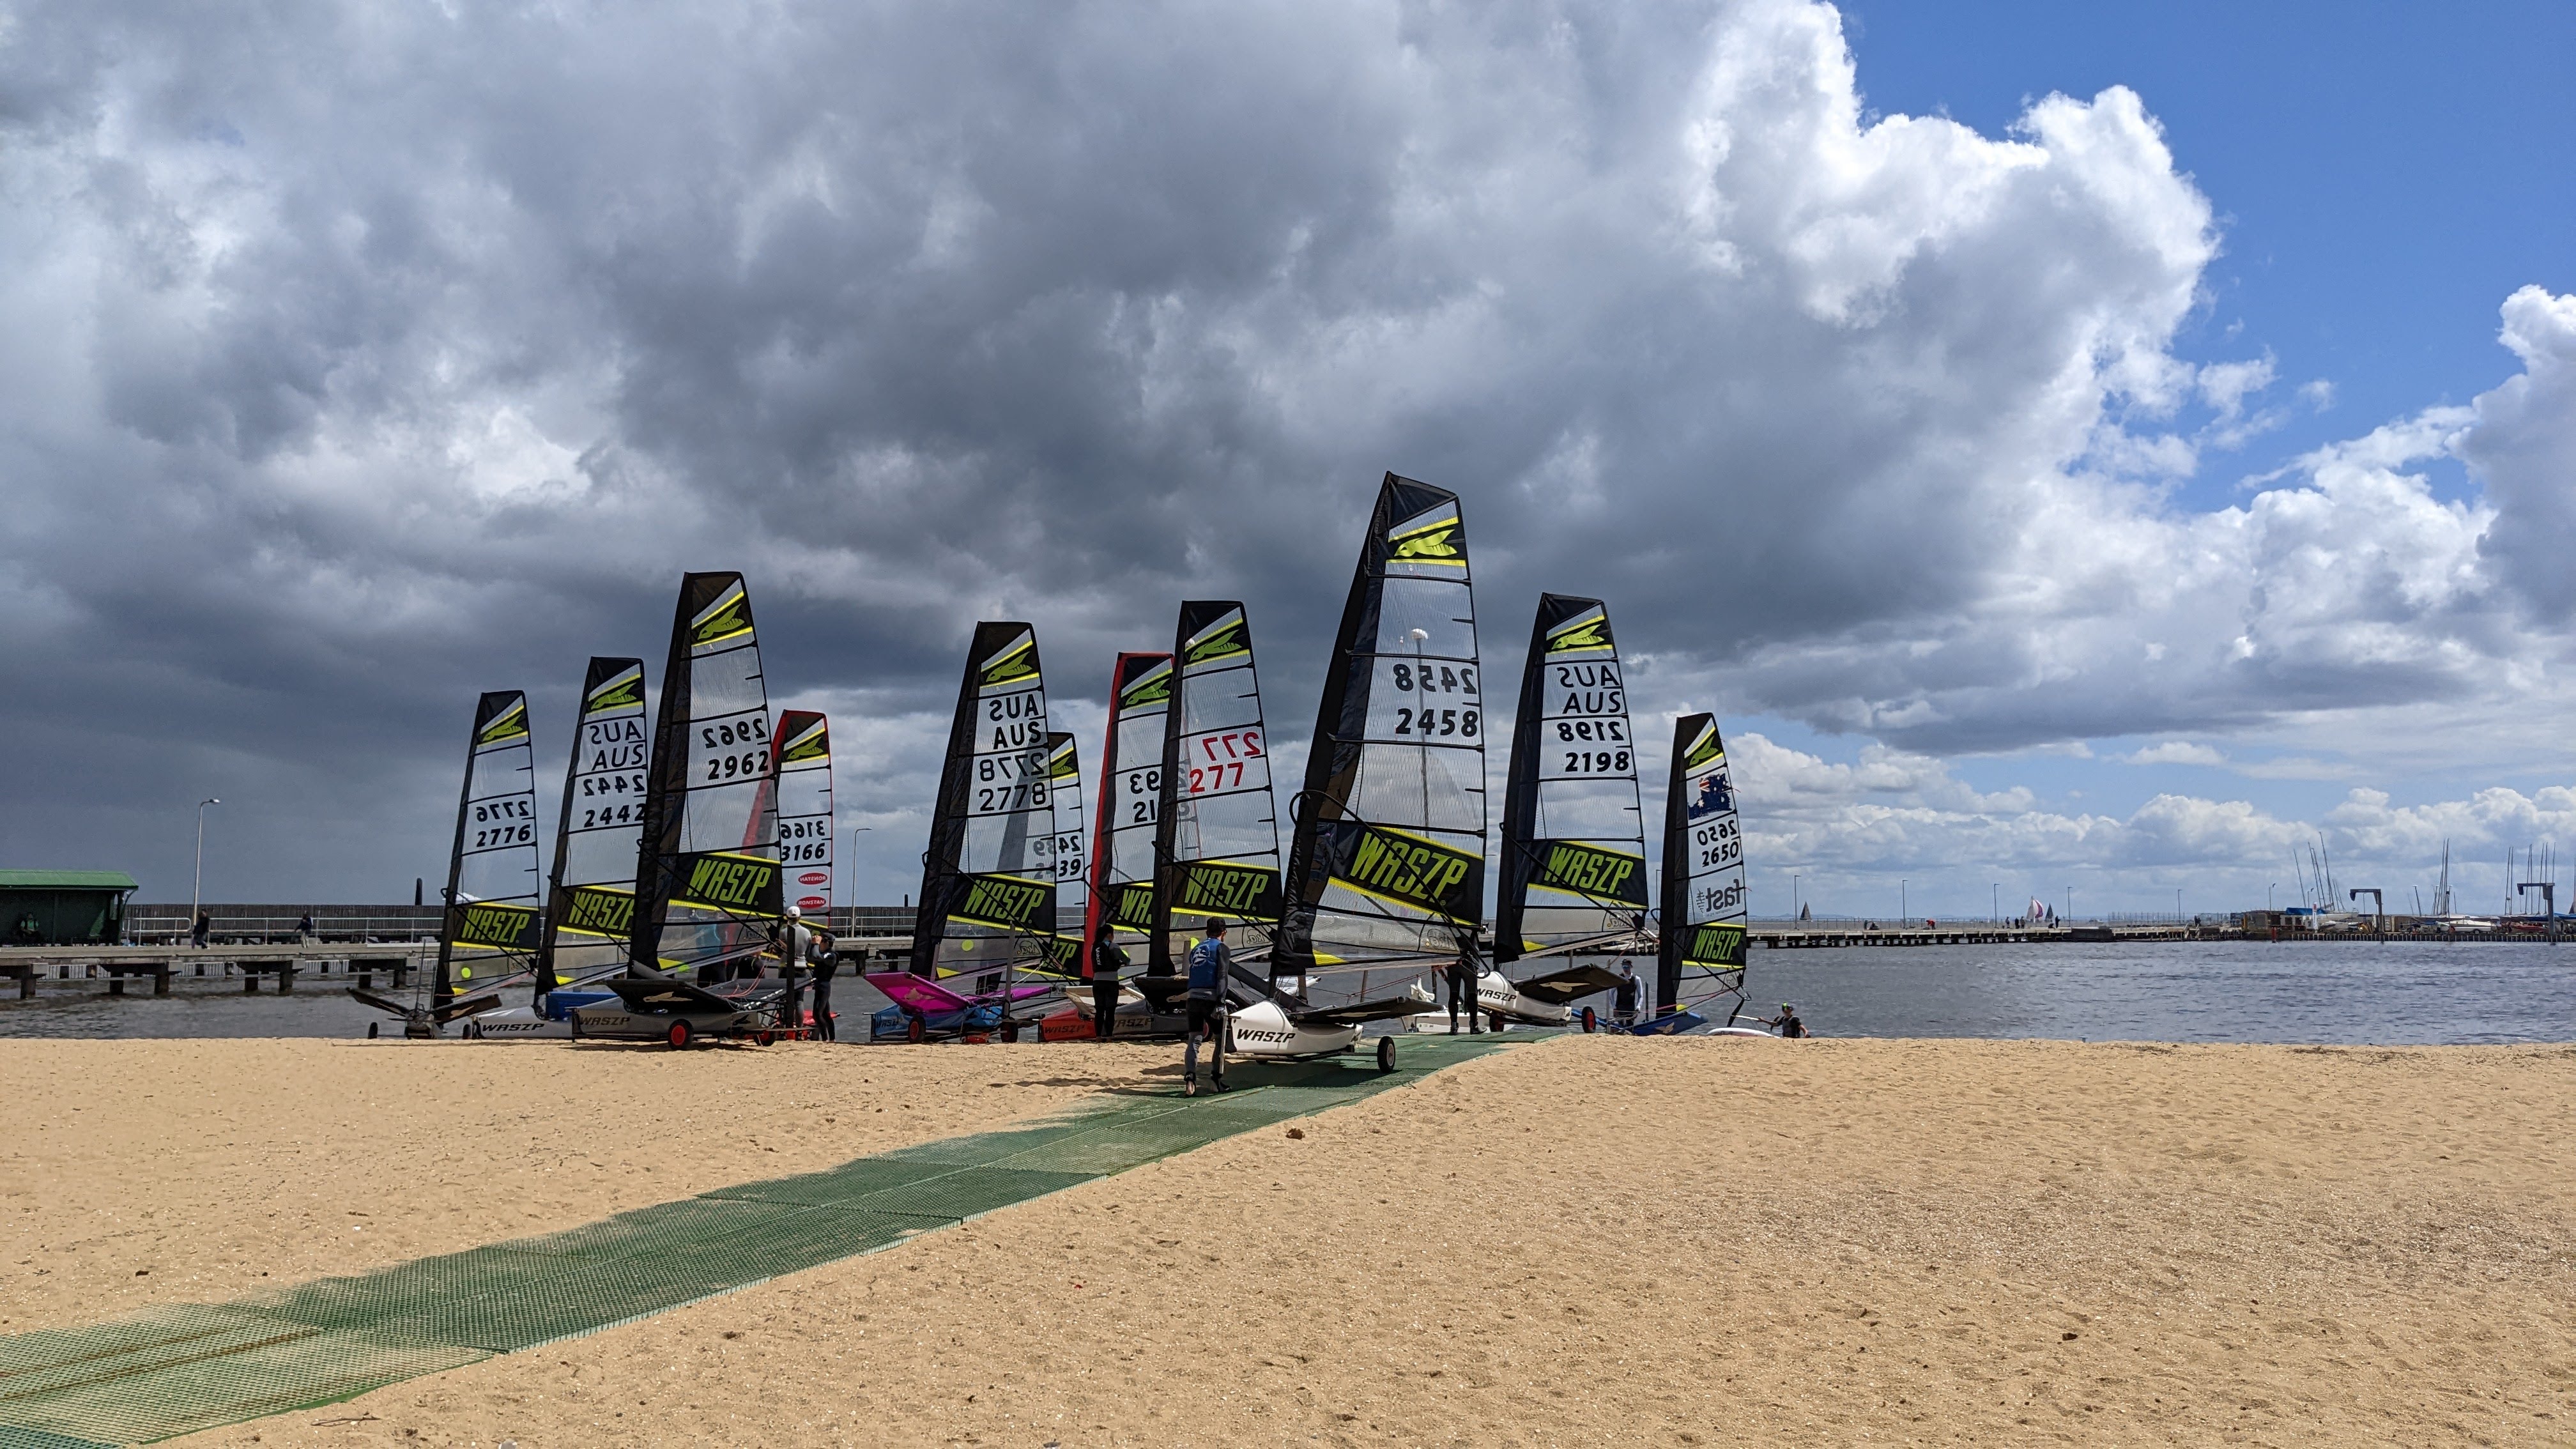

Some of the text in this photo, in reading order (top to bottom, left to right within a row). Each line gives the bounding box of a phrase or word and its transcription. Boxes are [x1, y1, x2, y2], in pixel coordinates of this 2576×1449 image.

[1562, 691, 1621, 714] AUS
[993, 722, 1041, 749] AUS
[1396, 708, 1478, 737] 2458
[592, 744, 643, 770] AUS
[707, 750, 769, 781] 2962
[1565, 751, 1629, 772] 2198
[1190, 762, 1244, 793] 277
[979, 782, 1046, 811] 2778
[585, 803, 645, 827] 2442
[1133, 799, 1156, 823] 21
[476, 824, 530, 848] 2776
[781, 843, 825, 862] 3166
[1702, 841, 1738, 867] 2650
[1351, 832, 1468, 904] WASZP
[1544, 846, 1633, 895] WASZP
[686, 859, 772, 905] WASZP
[1184, 868, 1269, 910] WASZP
[963, 880, 1046, 923] WASZP
[461, 908, 530, 943] WASZP
[1692, 929, 1742, 960] WASZP
[482, 1023, 545, 1032] WASZP
[580, 1016, 631, 1026] WASZP
[1045, 1024, 1085, 1034] WASZP
[1116, 1017, 1154, 1027] ASZP
[1236, 1029, 1296, 1043] WASZP
